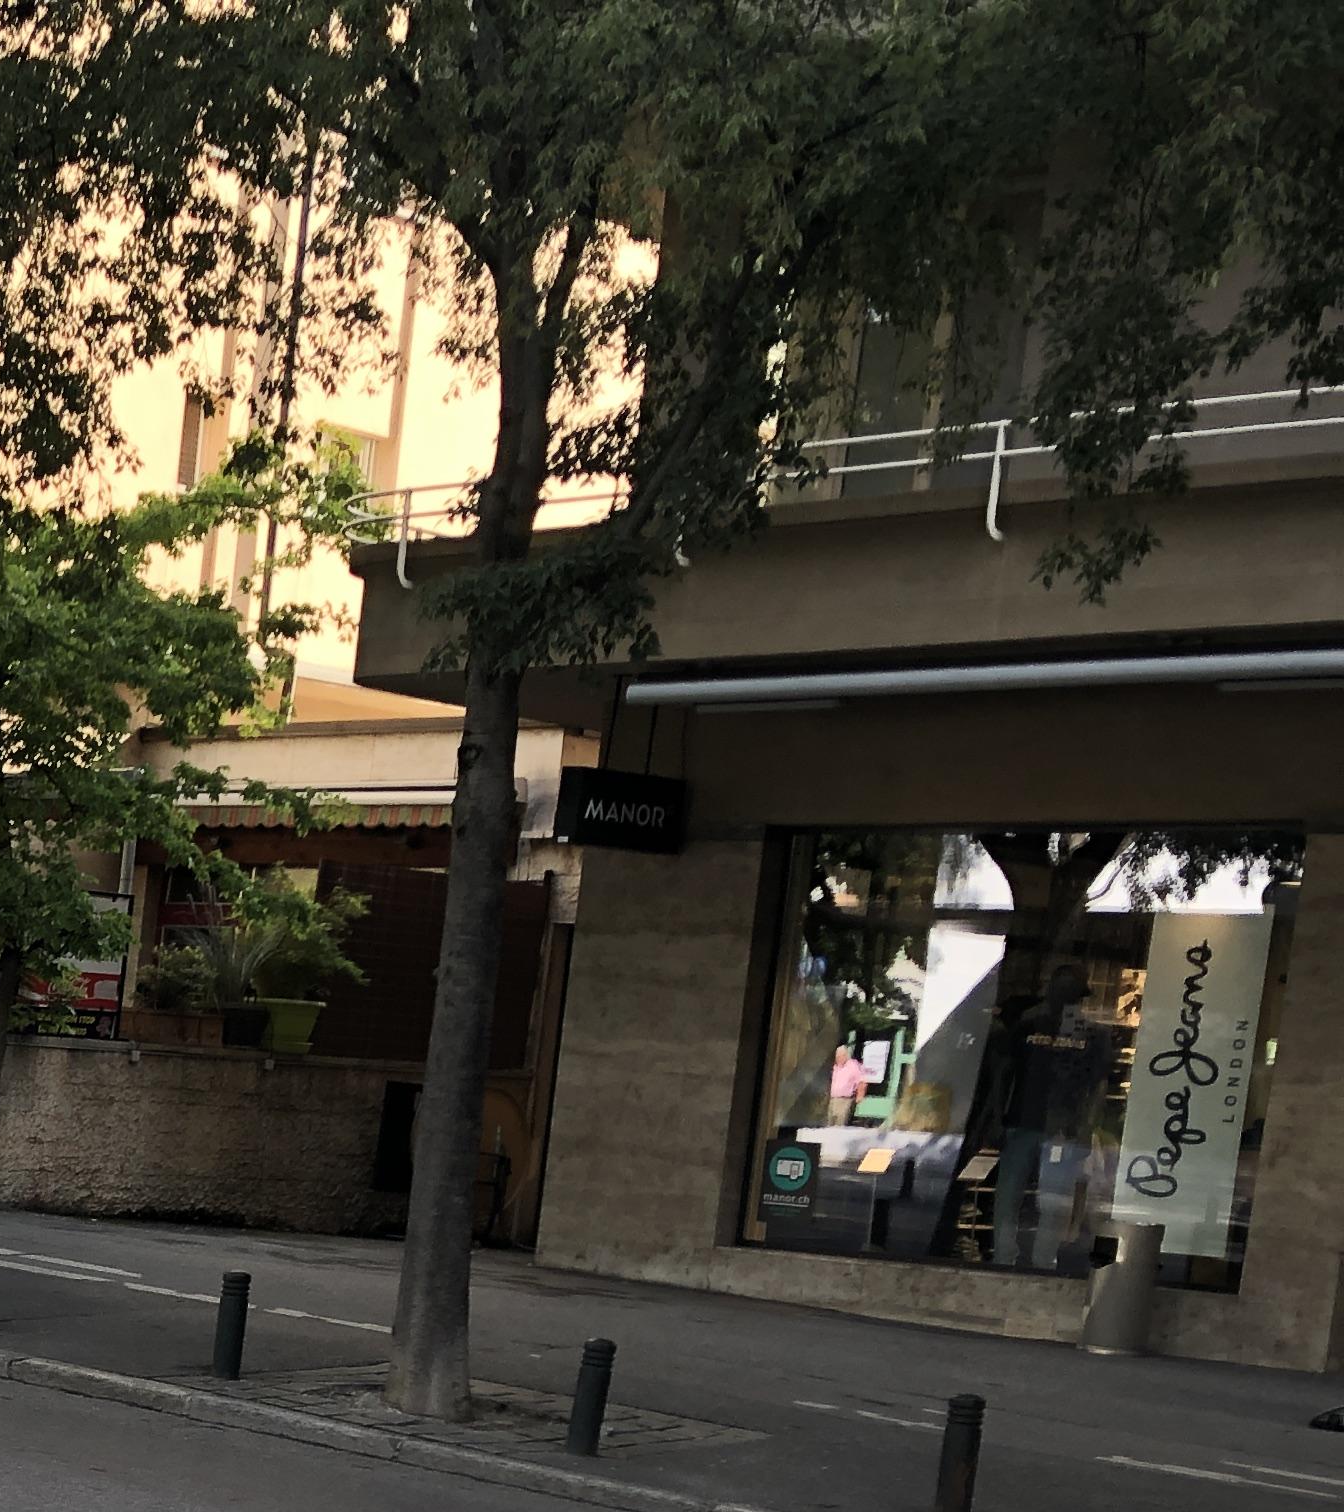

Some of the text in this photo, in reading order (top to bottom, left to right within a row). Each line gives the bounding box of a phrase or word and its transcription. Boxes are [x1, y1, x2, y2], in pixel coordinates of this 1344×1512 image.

[584, 797, 666, 829] MANOR
[1125, 937, 1220, 1198] Pepe Jeans
[1222, 1019, 1250, 1124] LONDON
[763, 1193, 810, 1205] manor.ch
